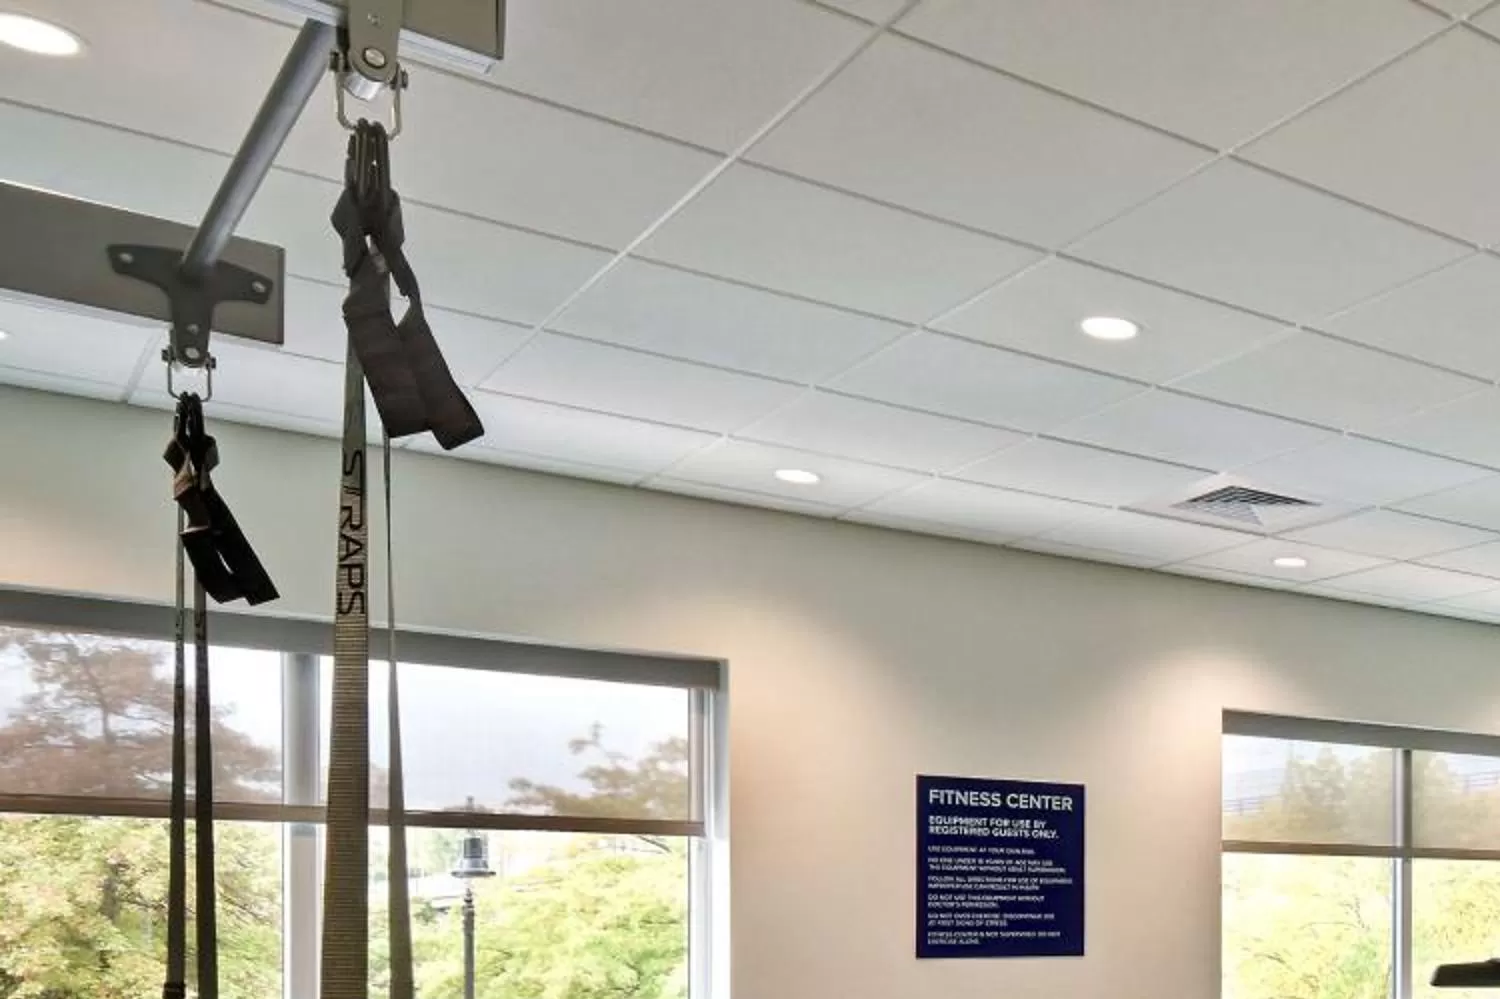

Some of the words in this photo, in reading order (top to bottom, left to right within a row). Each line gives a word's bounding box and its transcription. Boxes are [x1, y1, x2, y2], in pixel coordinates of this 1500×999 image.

[338, 451, 365, 615] STRAPS
[928, 789, 1001, 807] FITNESS
[1006, 793, 1073, 811] CENTER
[928, 815, 988, 828] EQUIPMENT
[989, 818, 1010, 829] FOR
[1012, 819, 1031, 830] USE
[1033, 820, 1047, 830] BY
[928, 826, 990, 837] REGISTERED
[991, 828, 1030, 839] GUESTS
[1032, 829, 1060, 840] ONLY.
